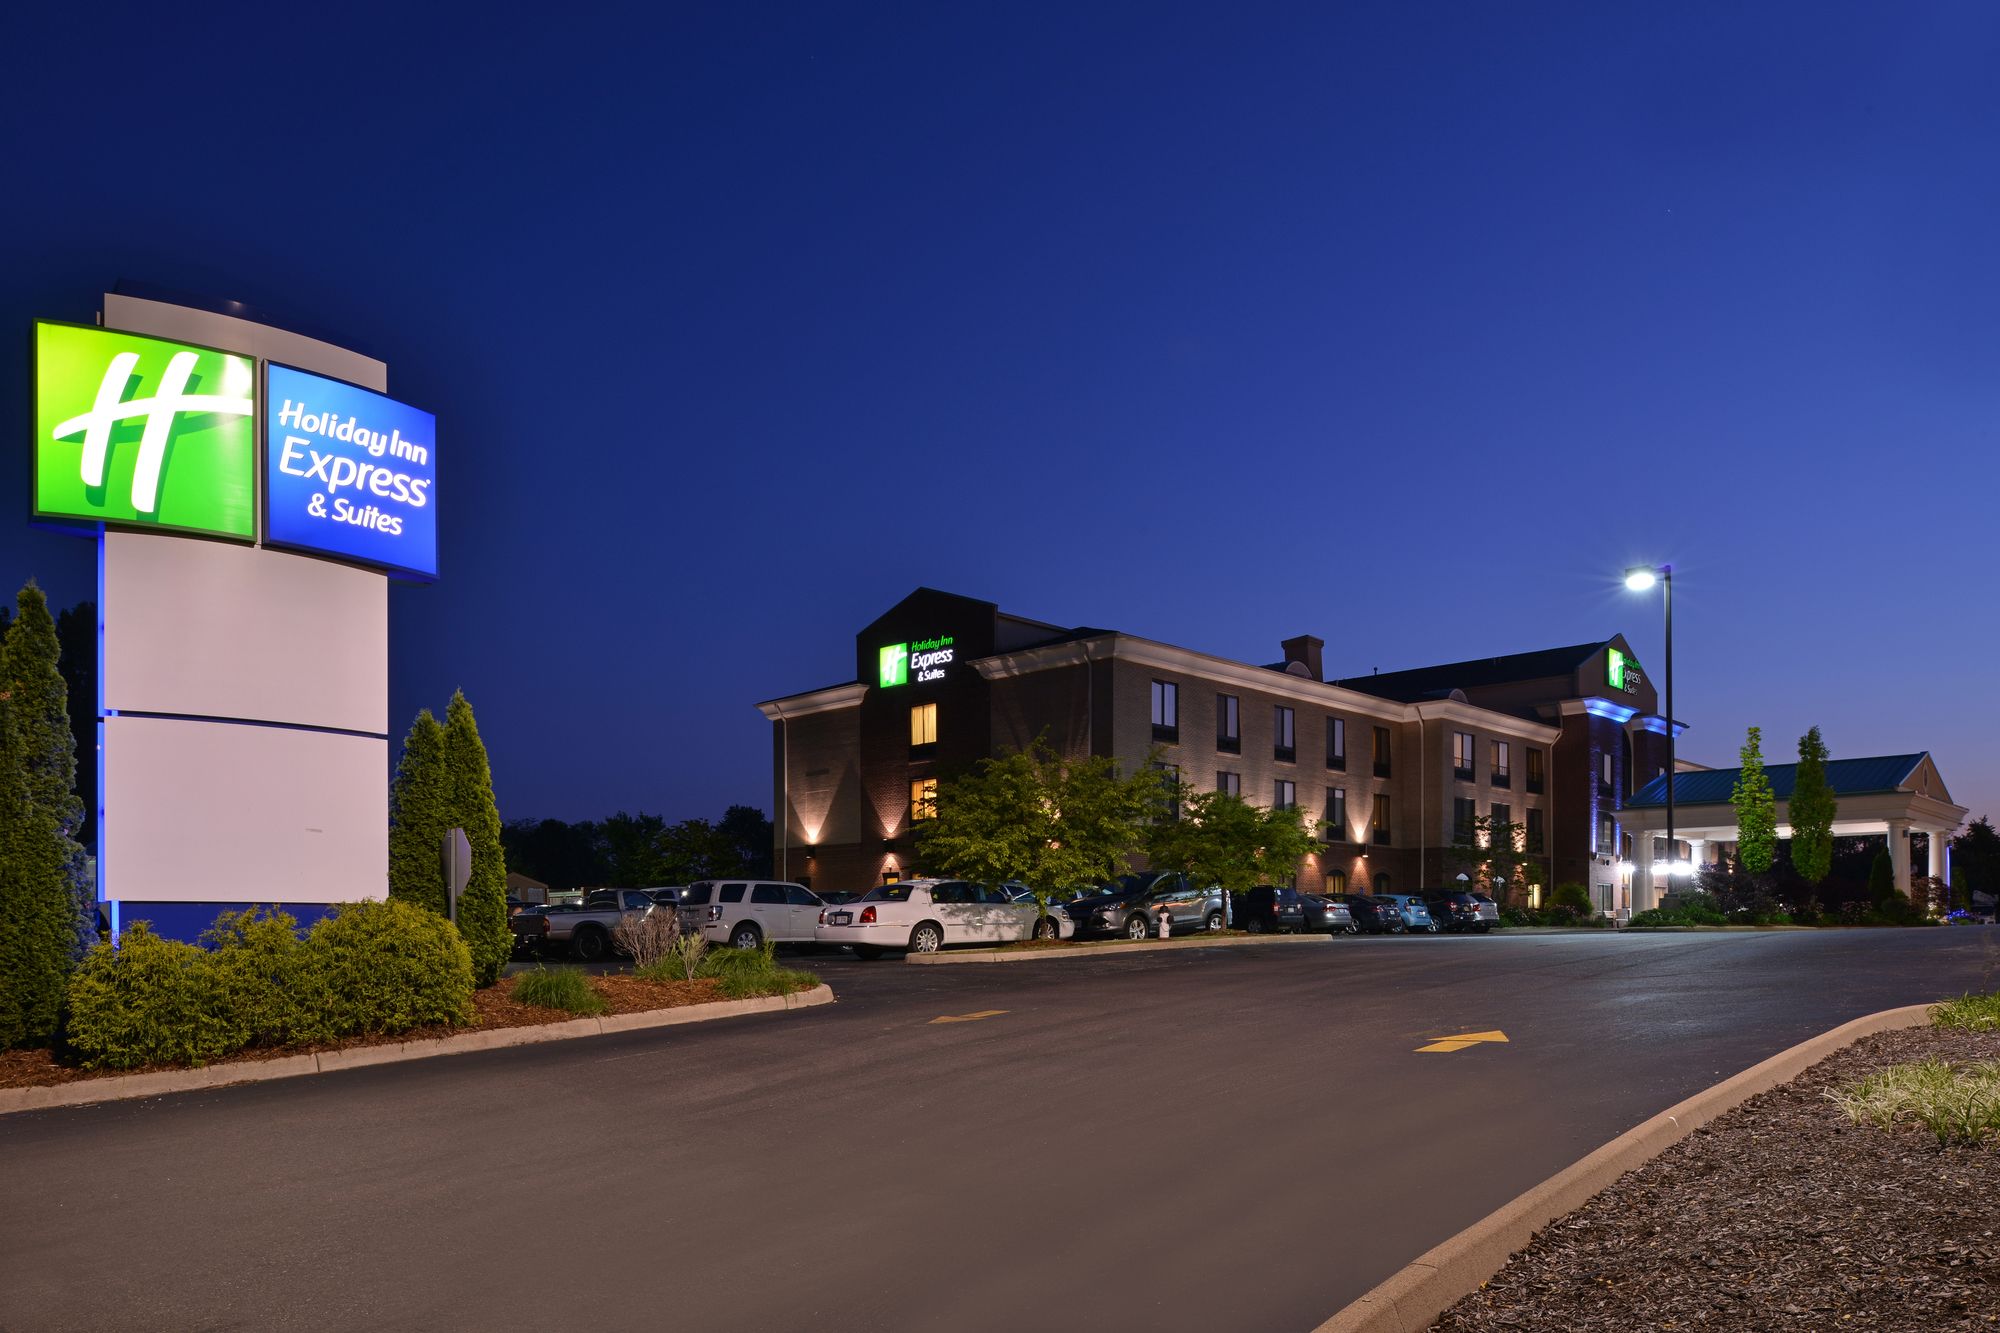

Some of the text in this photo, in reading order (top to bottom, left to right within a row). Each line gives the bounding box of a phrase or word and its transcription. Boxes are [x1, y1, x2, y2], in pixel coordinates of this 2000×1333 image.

[278, 399, 428, 466] Holiday Inn
[279, 435, 428, 507] Express
[307, 492, 403, 535] & Suites
[911, 635, 953, 652] Holiday Inn
[911, 649, 953, 671] Express
[924, 669, 945, 680] Suites
